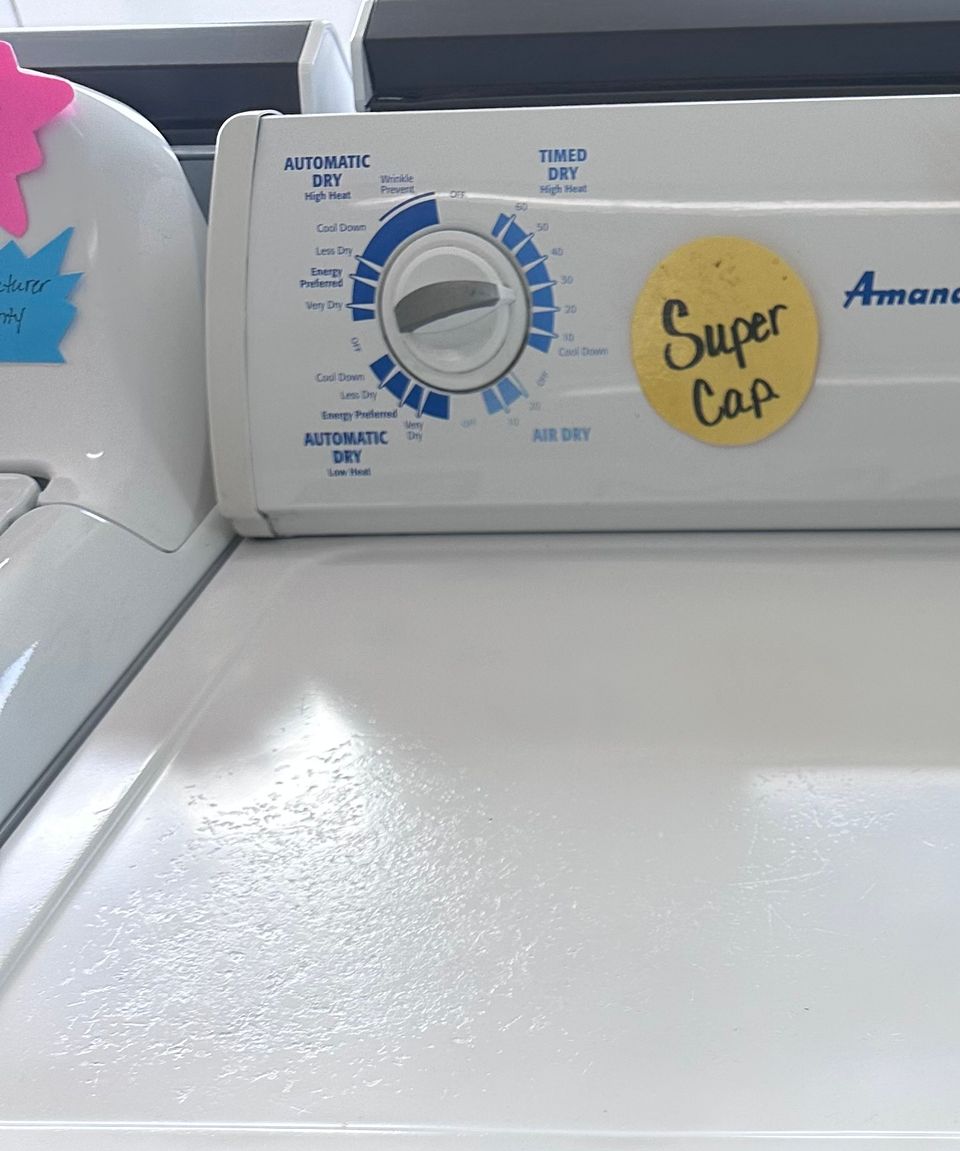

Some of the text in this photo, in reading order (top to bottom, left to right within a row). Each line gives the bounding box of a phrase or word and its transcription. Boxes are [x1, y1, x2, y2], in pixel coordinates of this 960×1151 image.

[539, 149, 587, 163] TIMED
[284, 155, 371, 170] AUTOMATIC
[548, 166, 579, 181] DRY
[312, 174, 342, 187] DRY
[380, 174, 414, 184] Wrinkle
[380, 185, 415, 194] Prevent
[539, 185, 587, 196] High Heat
[305, 192, 352, 202] High Heat
[515, 203, 528, 211] 60
[317, 224, 367, 233] Cool Down
[537, 223, 549, 232] 50
[316, 247, 352, 257] Less Dry
[311, 267, 343, 278] Energy
[300, 279, 344, 288] Preferred
[306, 300, 343, 312] Very Dry
[565, 305, 577, 314] 20
[662, 299, 788, 370] Super
[558, 347, 609, 357] Cool Down
[315, 373, 365, 382] Cool Down
[341, 390, 377, 400] Less Dry
[693, 378, 780, 426] Cap
[322, 409, 398, 421] Energy Preferred
[405, 421, 423, 430] Very
[304, 431, 389, 446] AUTOMATIC
[407, 432, 423, 441] Dry
[532, 427, 591, 443] AIR DRY
[333, 450, 363, 464] DRY
[328, 468, 371, 477] Low Heat
